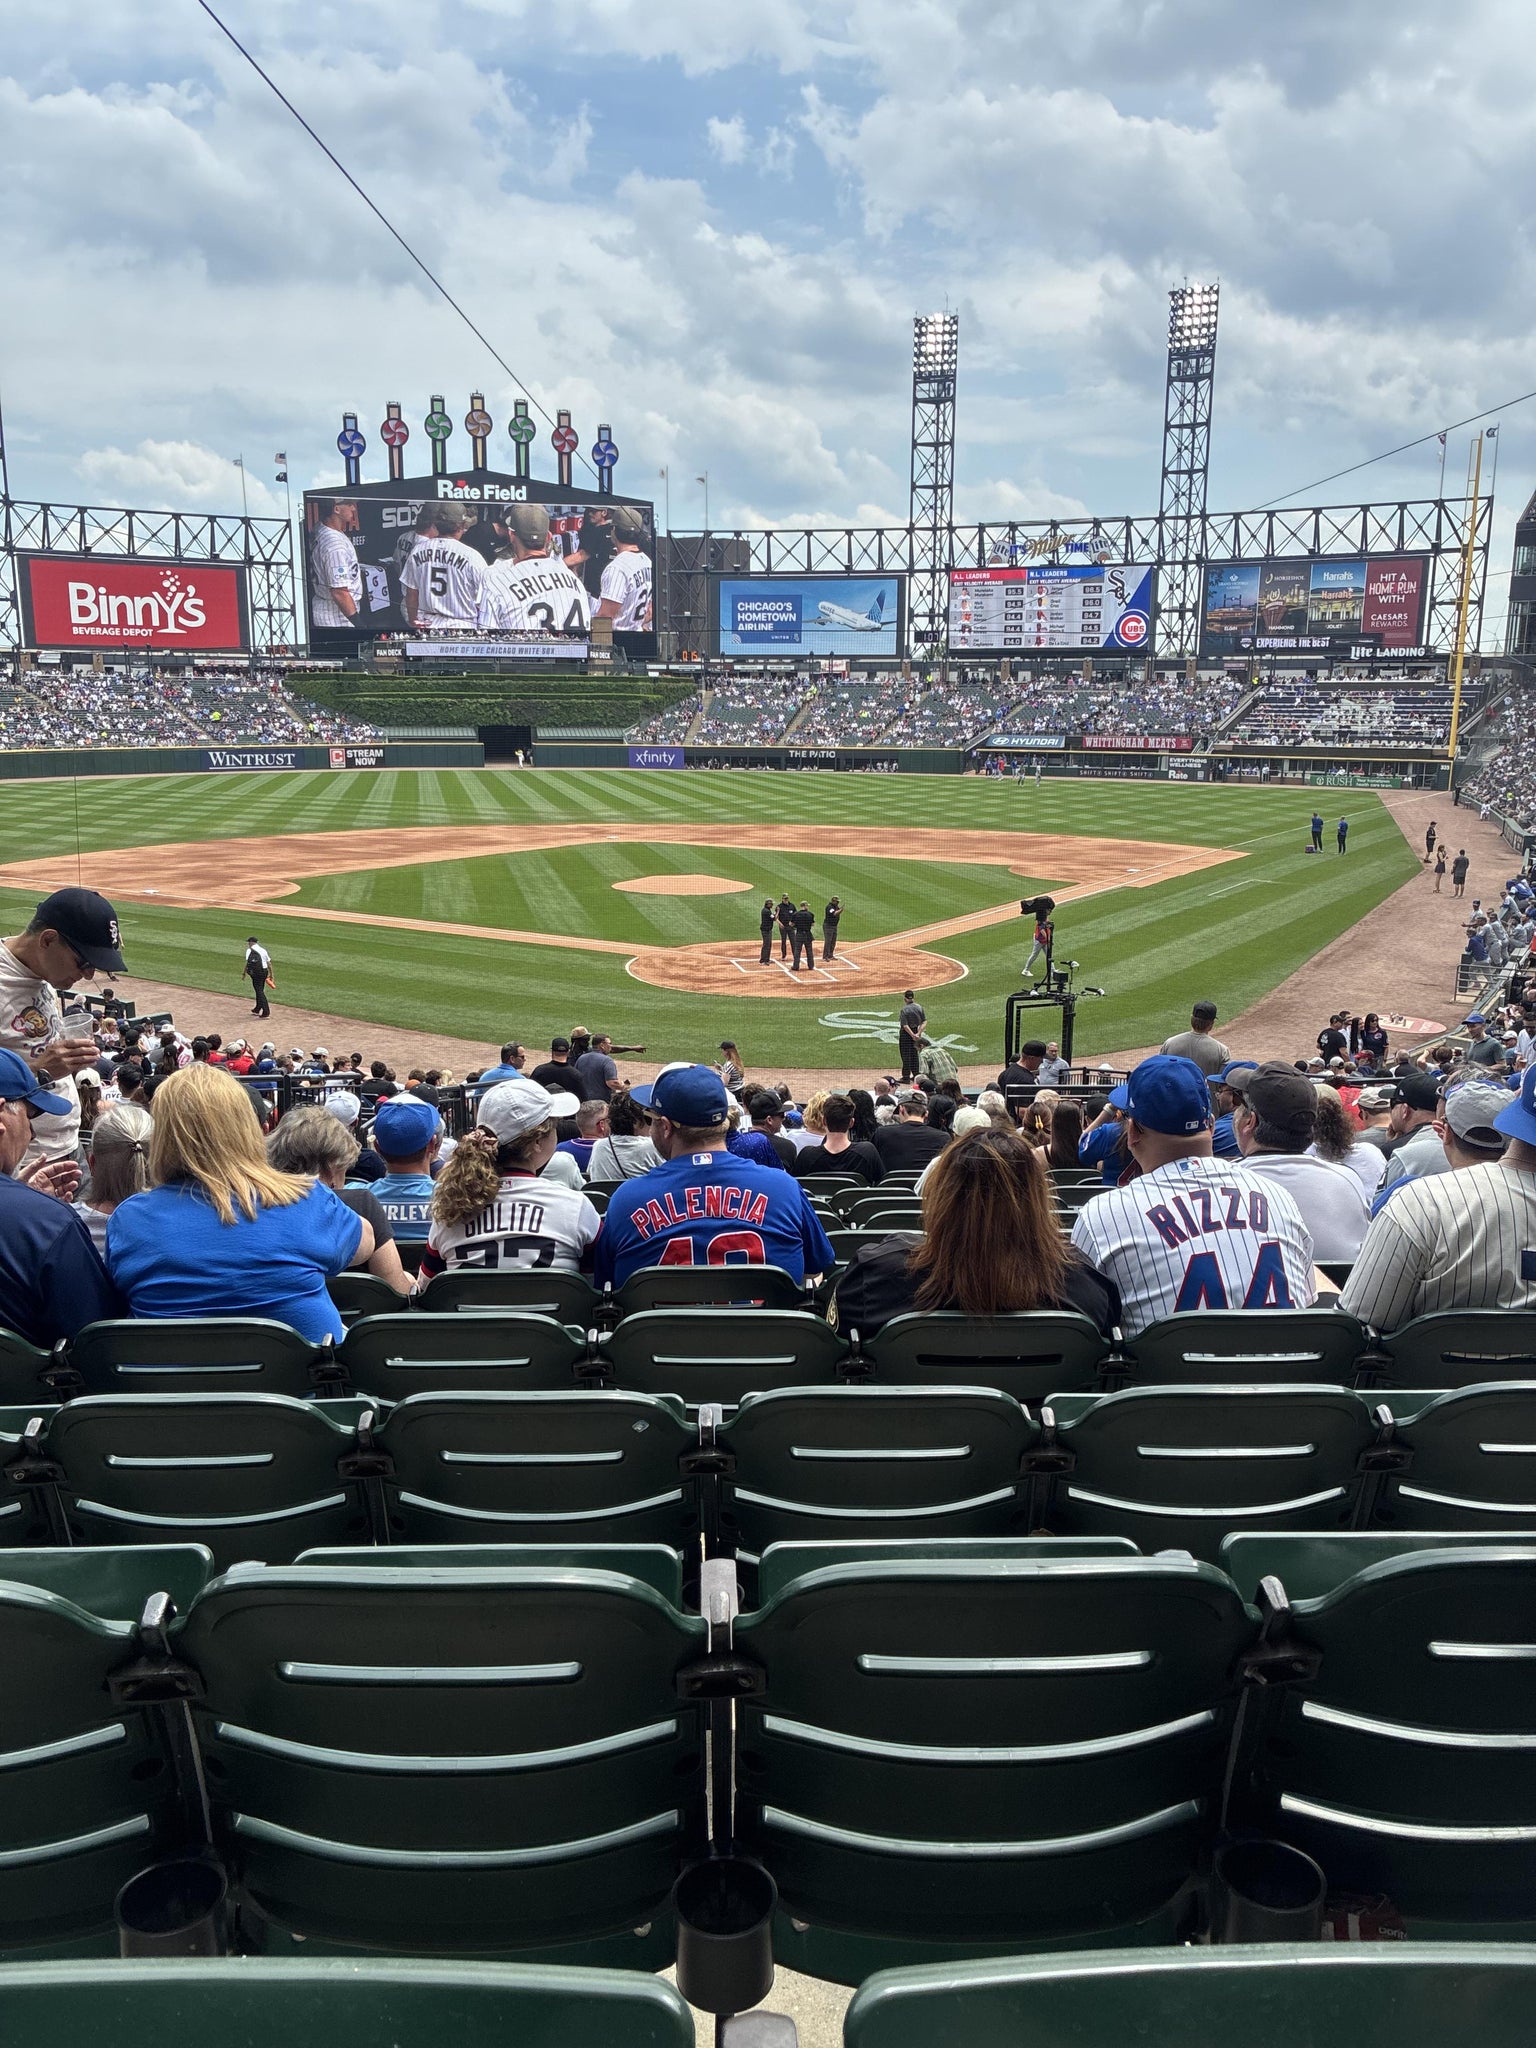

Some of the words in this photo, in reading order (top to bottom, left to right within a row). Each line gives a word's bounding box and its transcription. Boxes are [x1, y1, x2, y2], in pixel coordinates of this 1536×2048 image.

[437, 479, 481, 500] Rate
[483, 484, 527, 501] Field
[1065, 542, 1089, 553] TIME
[430, 566, 448, 597] 5
[1380, 573, 1397, 582] HIT
[1399, 572, 1407, 581] A
[508, 572, 581, 601] GRICHUK
[1369, 582, 1395, 595] HOME
[1397, 581, 1417, 594] RUN
[1378, 595, 1405, 604] WITH
[737, 601, 793, 612] CHICAGO'S
[527, 598, 587, 631] 34
[737, 612, 797, 622] HOMETOWN
[1370, 613, 1408, 621] CAESARS
[72, 626, 121, 636] BEVERAGE
[122, 627, 153, 637] DEPOT
[737, 623, 774, 632] AIRLINE
[1256, 637, 1297, 649] EXPERIENCE
[1298, 637, 1311, 648] THE
[1311, 636, 1331, 648] BEST
[439, 646, 459, 654] HOME
[486, 647, 516, 655] CHICAGO
[518, 647, 540, 655] WHITE
[541, 647, 555, 655] SOX
[1350, 646, 1373, 660] Lite
[1376, 647, 1426, 657] LANDING
[1011, 737, 1059, 746] HYUNDAI
[1085, 736, 1145, 749] WHITTINGHAM
[1148, 737, 1177, 749] MEATS
[208, 751, 296, 767] WINTRUST
[346, 749, 384, 758] STREAM
[635, 750, 676, 766] xfinity
[789, 750, 807, 758] THE
[809, 750, 836, 759] PATIO
[355, 758, 376, 766] NOW
[1168, 769, 1189, 780] Rate
[1326, 775, 1353, 787] RUSH
[630, 1185, 769, 1241] PALENCIA
[1145, 1186, 1269, 1250] RIZZO
[1173, 1241, 1296, 1313] 44
